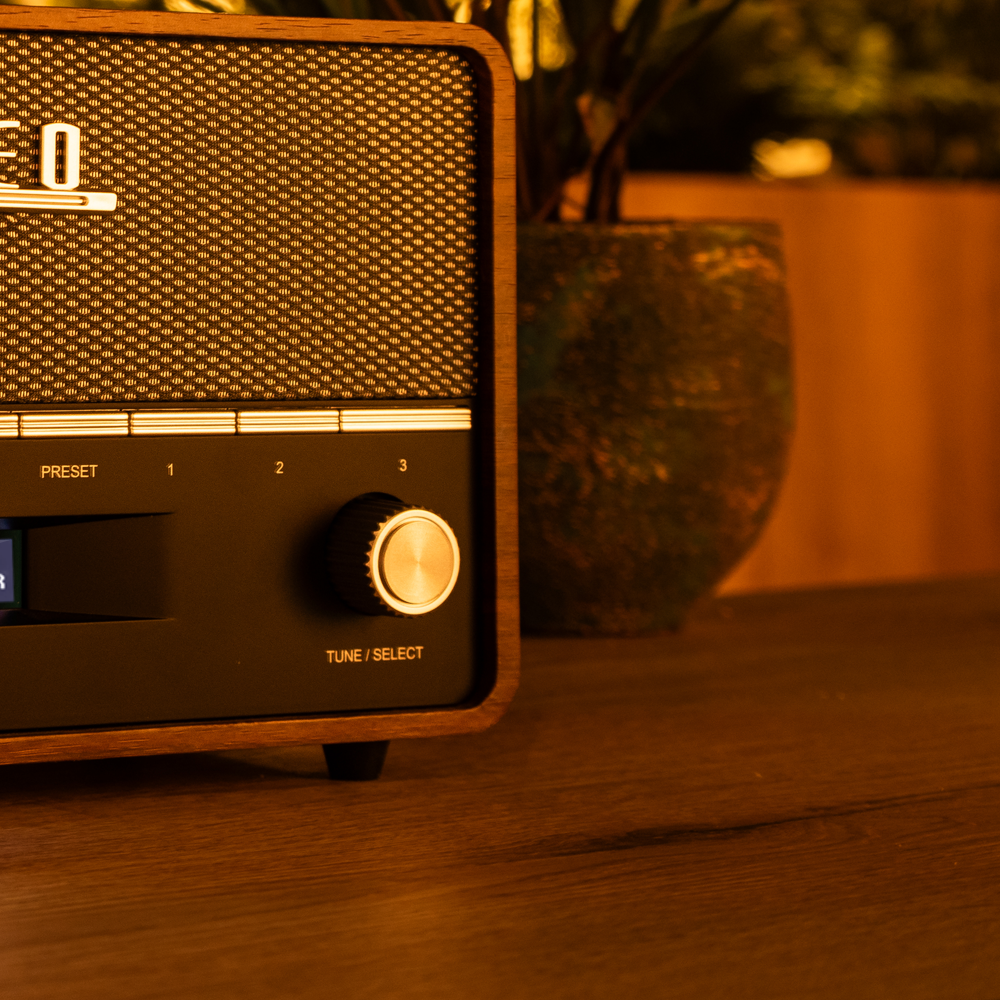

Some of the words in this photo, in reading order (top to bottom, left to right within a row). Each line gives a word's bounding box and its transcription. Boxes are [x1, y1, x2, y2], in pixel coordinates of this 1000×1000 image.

[39, 463, 99, 479] PRESET
[166, 462, 175, 477] 1
[274, 460, 285, 475] 2
[398, 458, 408, 473] 3
[325, 648, 364, 664] TUNE
[365, 648, 372, 663] /
[372, 645, 425, 662] SELECT
